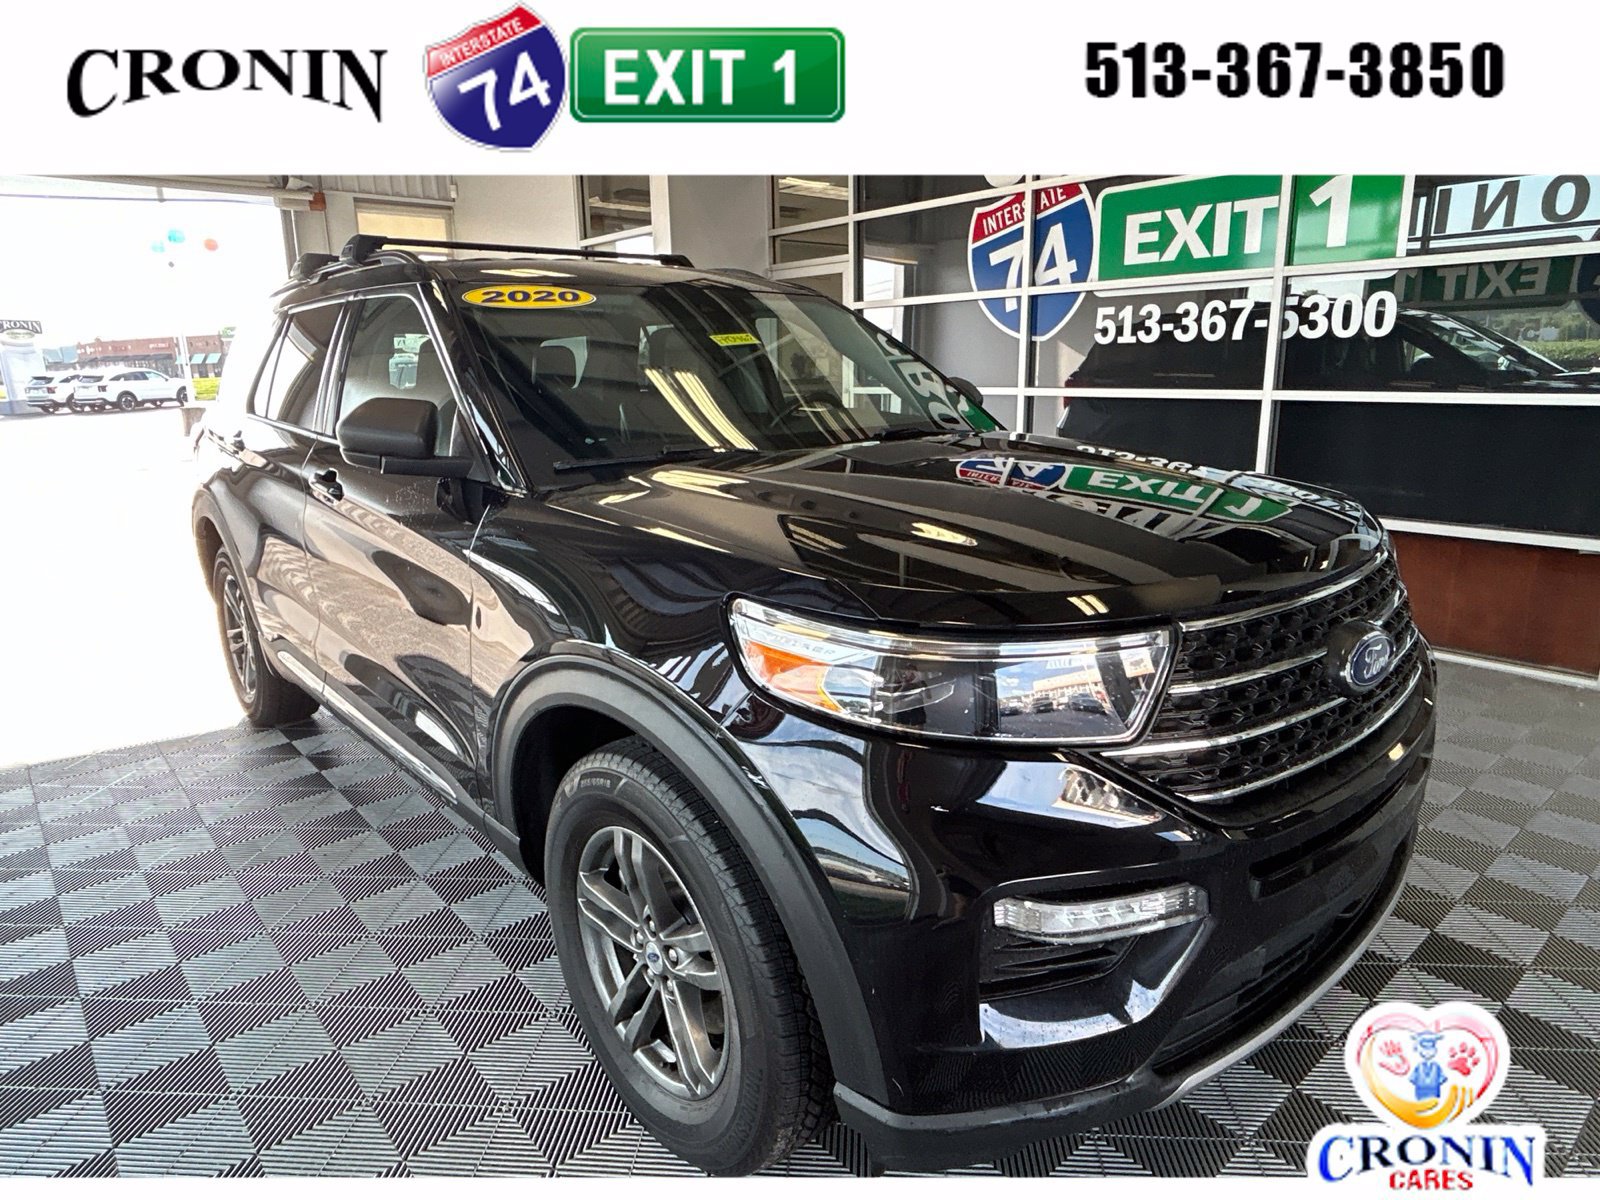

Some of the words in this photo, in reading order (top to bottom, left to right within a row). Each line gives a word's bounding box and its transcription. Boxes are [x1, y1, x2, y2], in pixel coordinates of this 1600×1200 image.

[983, 187, 1067, 236] INTERATE
[1124, 195, 1280, 266] EXIT
[1309, 175, 1354, 248] 1
[988, 222, 1078, 313] 74
[481, 290, 581, 303] 2020
[1093, 290, 1398, 345] 513-367-5300
[1363, 643, 1389, 680] Ford
